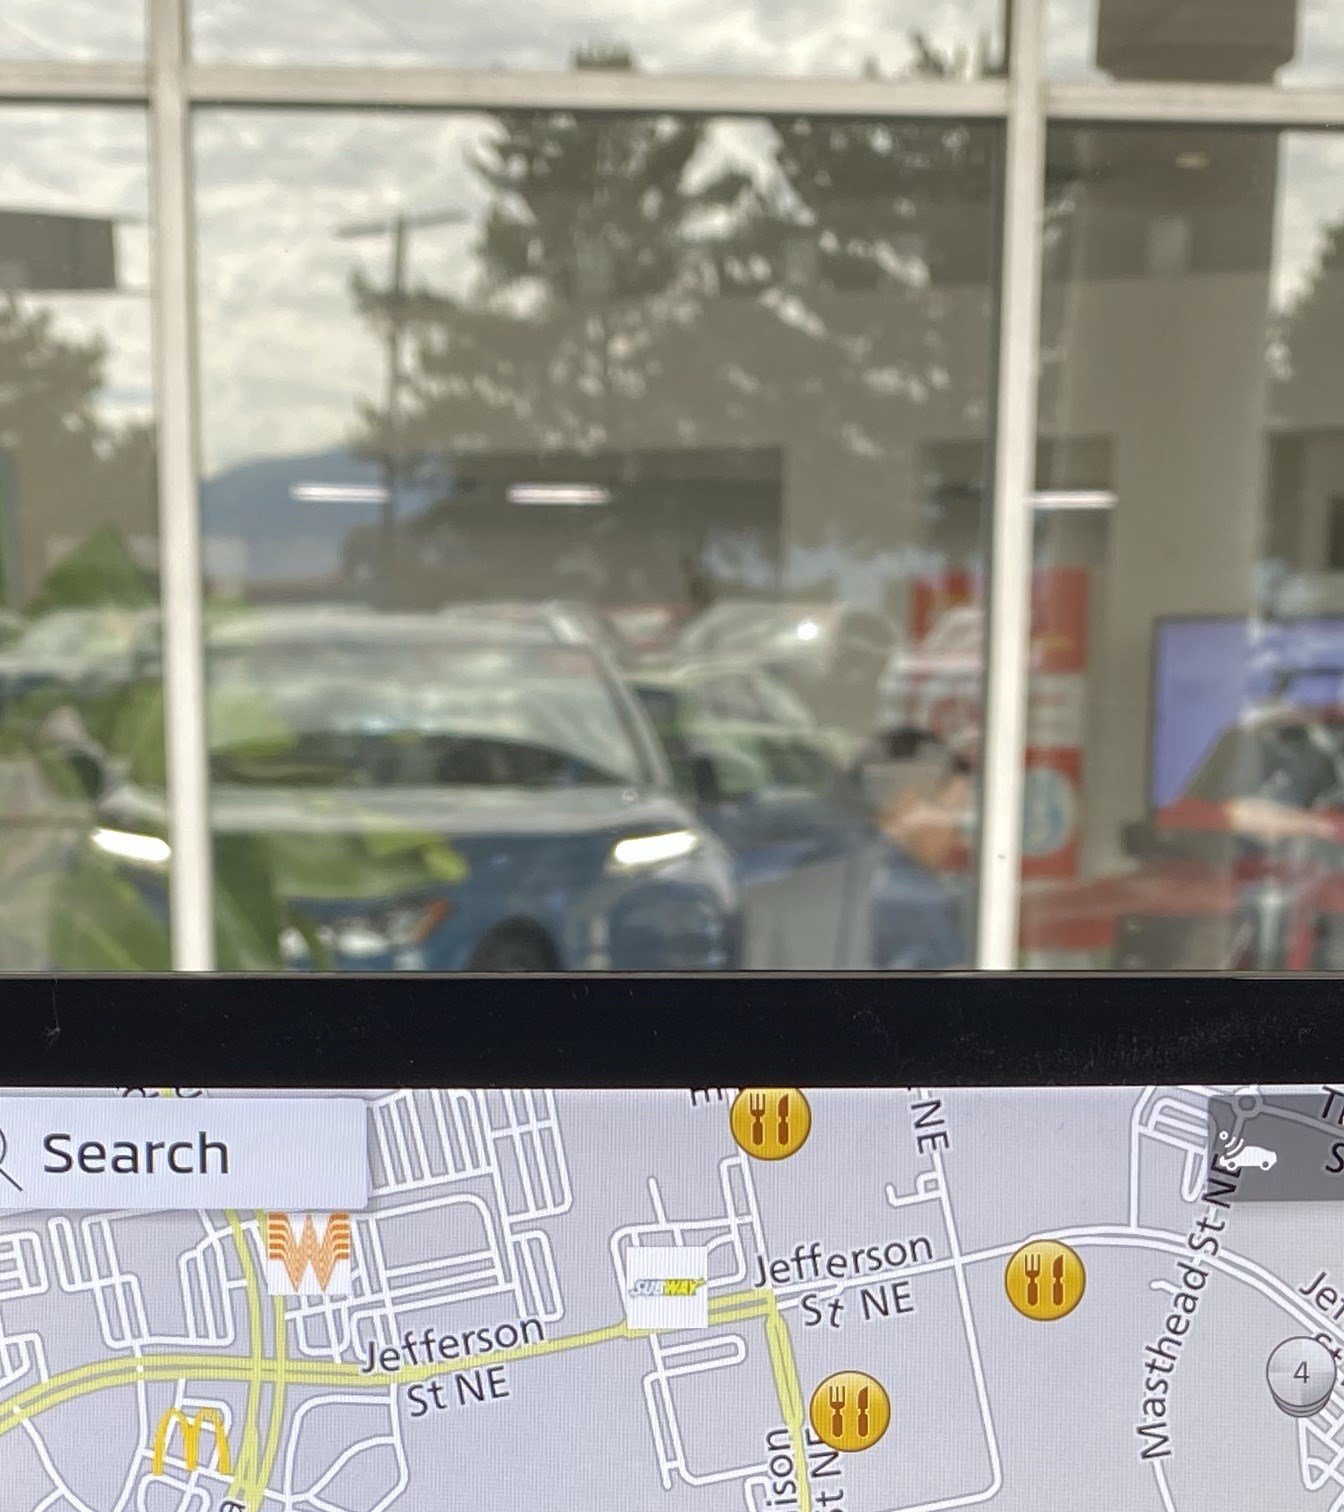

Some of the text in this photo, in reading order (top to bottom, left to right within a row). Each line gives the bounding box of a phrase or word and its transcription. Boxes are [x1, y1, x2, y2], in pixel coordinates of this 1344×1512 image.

[911, 1099, 950, 1154] NE
[42, 1131, 230, 1175] Search
[755, 1235, 933, 1287] Jefferson
[628, 1277, 707, 1298] SUBWAY
[801, 1281, 914, 1328] St NE
[361, 1317, 545, 1374] Jefferson
[1136, 1261, 1209, 1460] Masthead
[1187, 1216, 1226, 1256] St
[406, 1365, 510, 1418] St NE
[1292, 1360, 1311, 1384] 4
